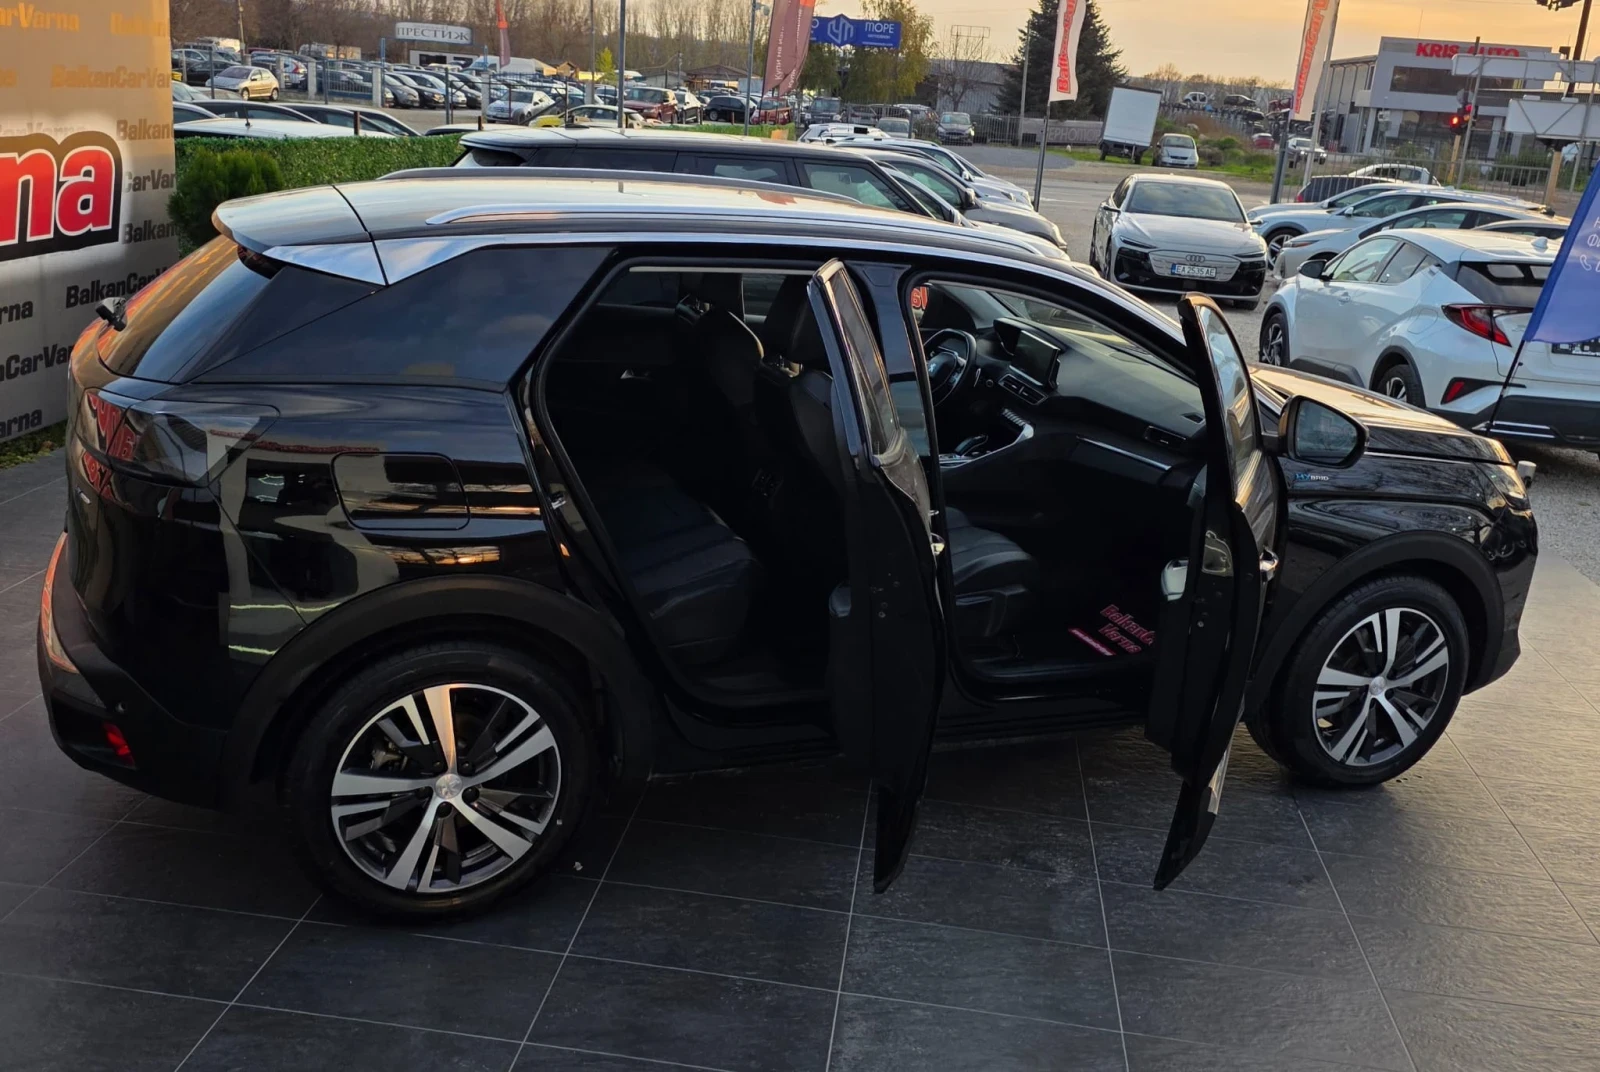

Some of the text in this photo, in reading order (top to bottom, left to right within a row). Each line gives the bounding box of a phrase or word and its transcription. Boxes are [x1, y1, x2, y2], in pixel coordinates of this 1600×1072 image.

[397, 27, 469, 41] ПРЕСТИЖ
[865, 21, 895, 34] МОРЕ
[1416, 43, 1459, 58] KRIS
[116, 119, 174, 142] Balkan
